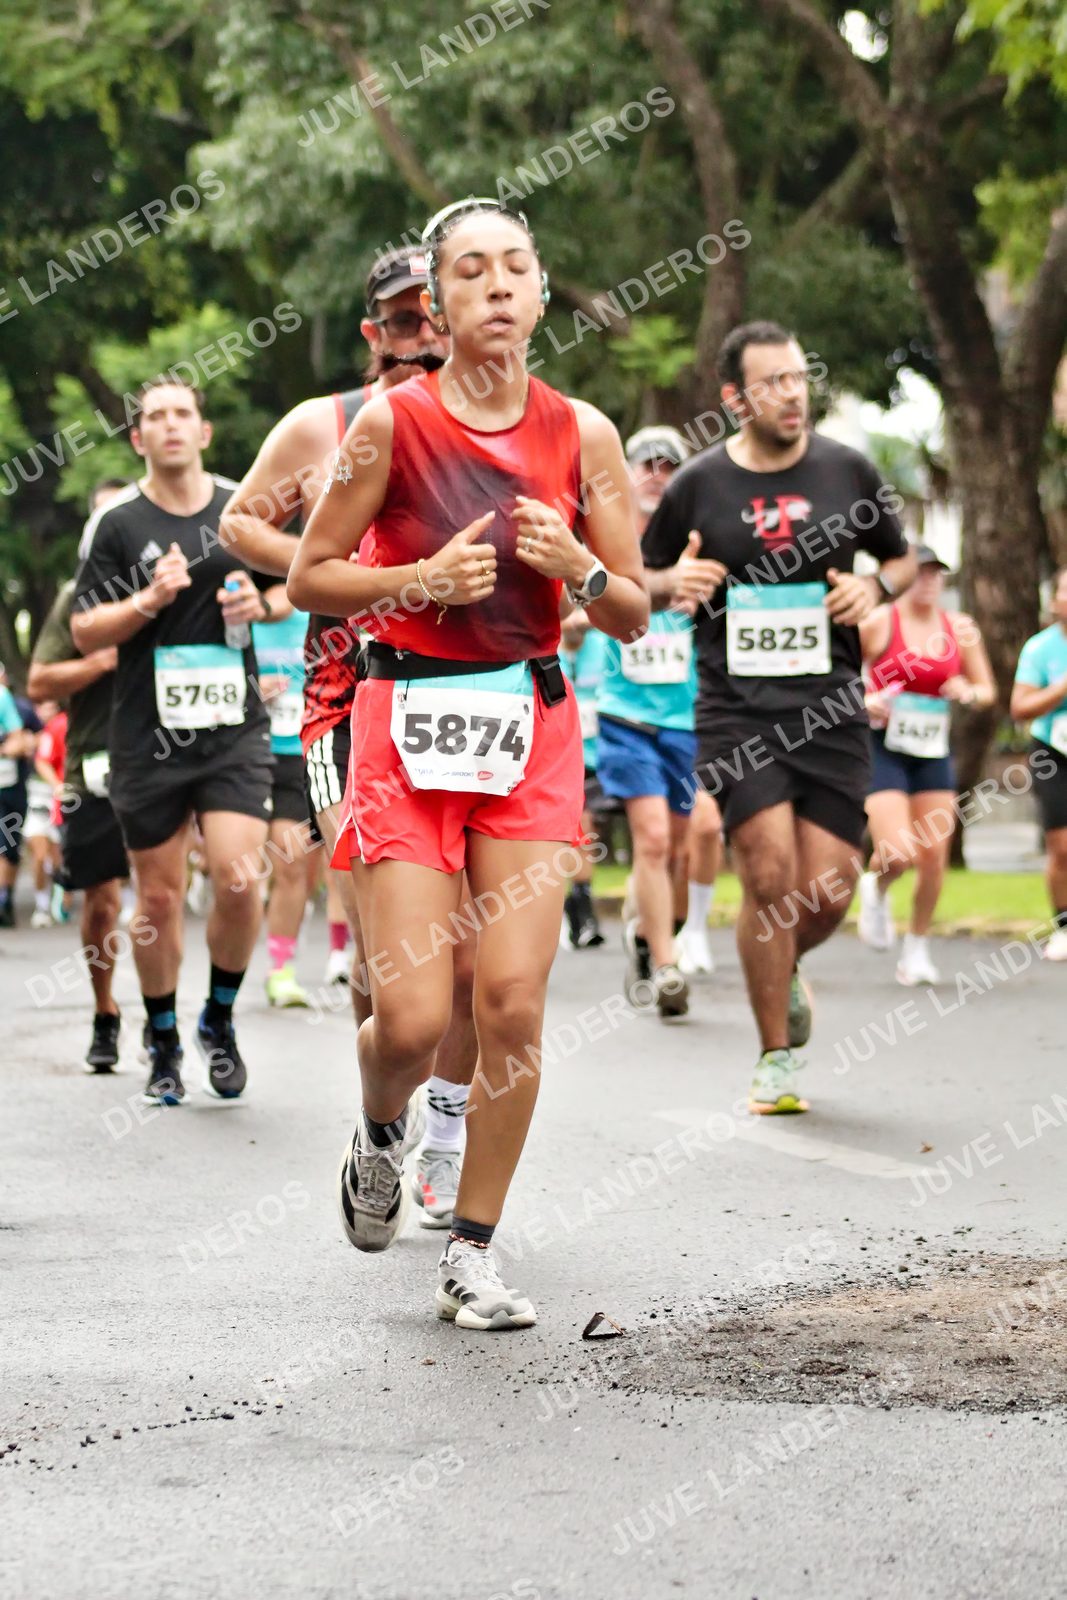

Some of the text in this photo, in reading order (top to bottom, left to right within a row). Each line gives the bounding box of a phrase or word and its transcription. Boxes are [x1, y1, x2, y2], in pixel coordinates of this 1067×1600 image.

[738, 626, 818, 650] 5825
[166, 684, 237, 707] 5768
[401, 713, 525, 761] 5874
